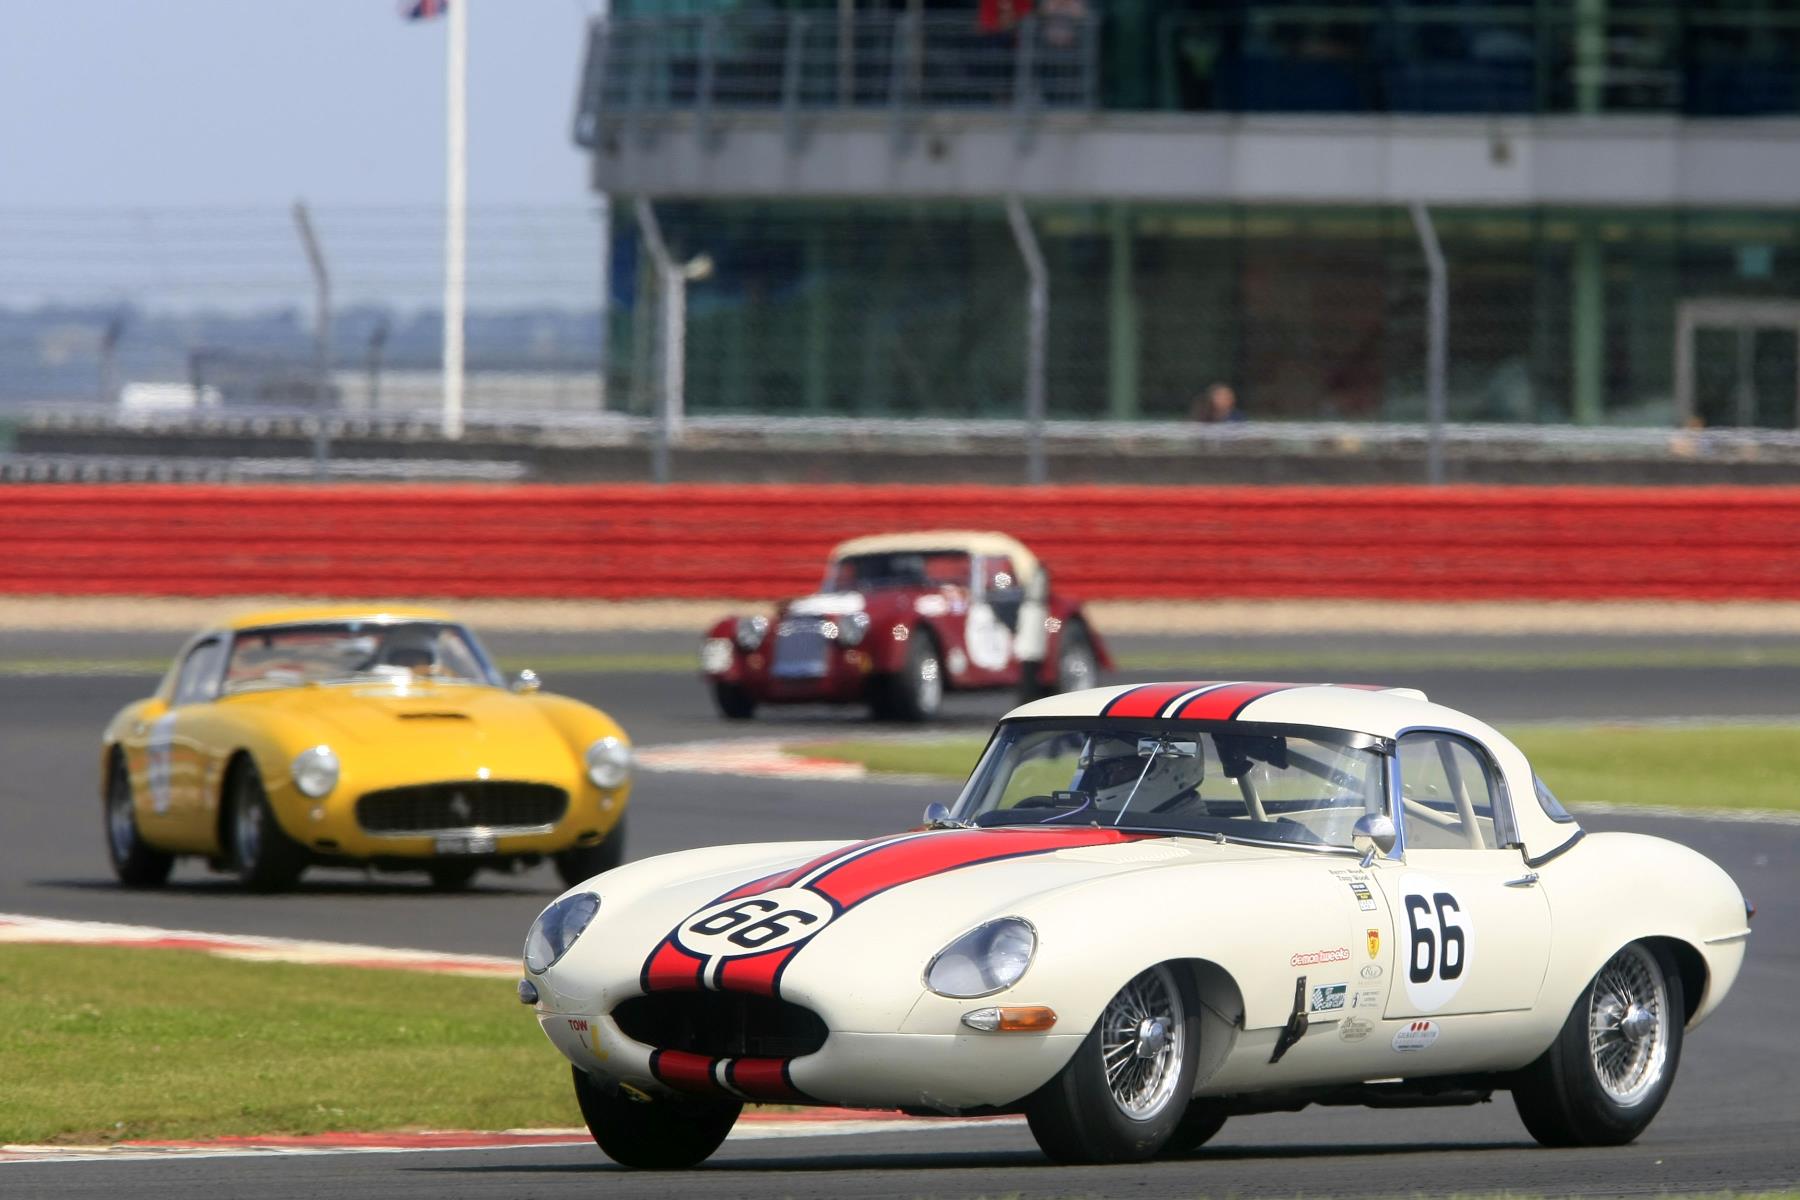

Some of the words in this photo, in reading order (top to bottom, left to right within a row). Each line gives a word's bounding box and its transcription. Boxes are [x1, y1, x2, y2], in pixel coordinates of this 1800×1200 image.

[688, 899, 818, 949] 66
[1404, 892, 1466, 984] 66
[567, 1019, 588, 1031] TOW
